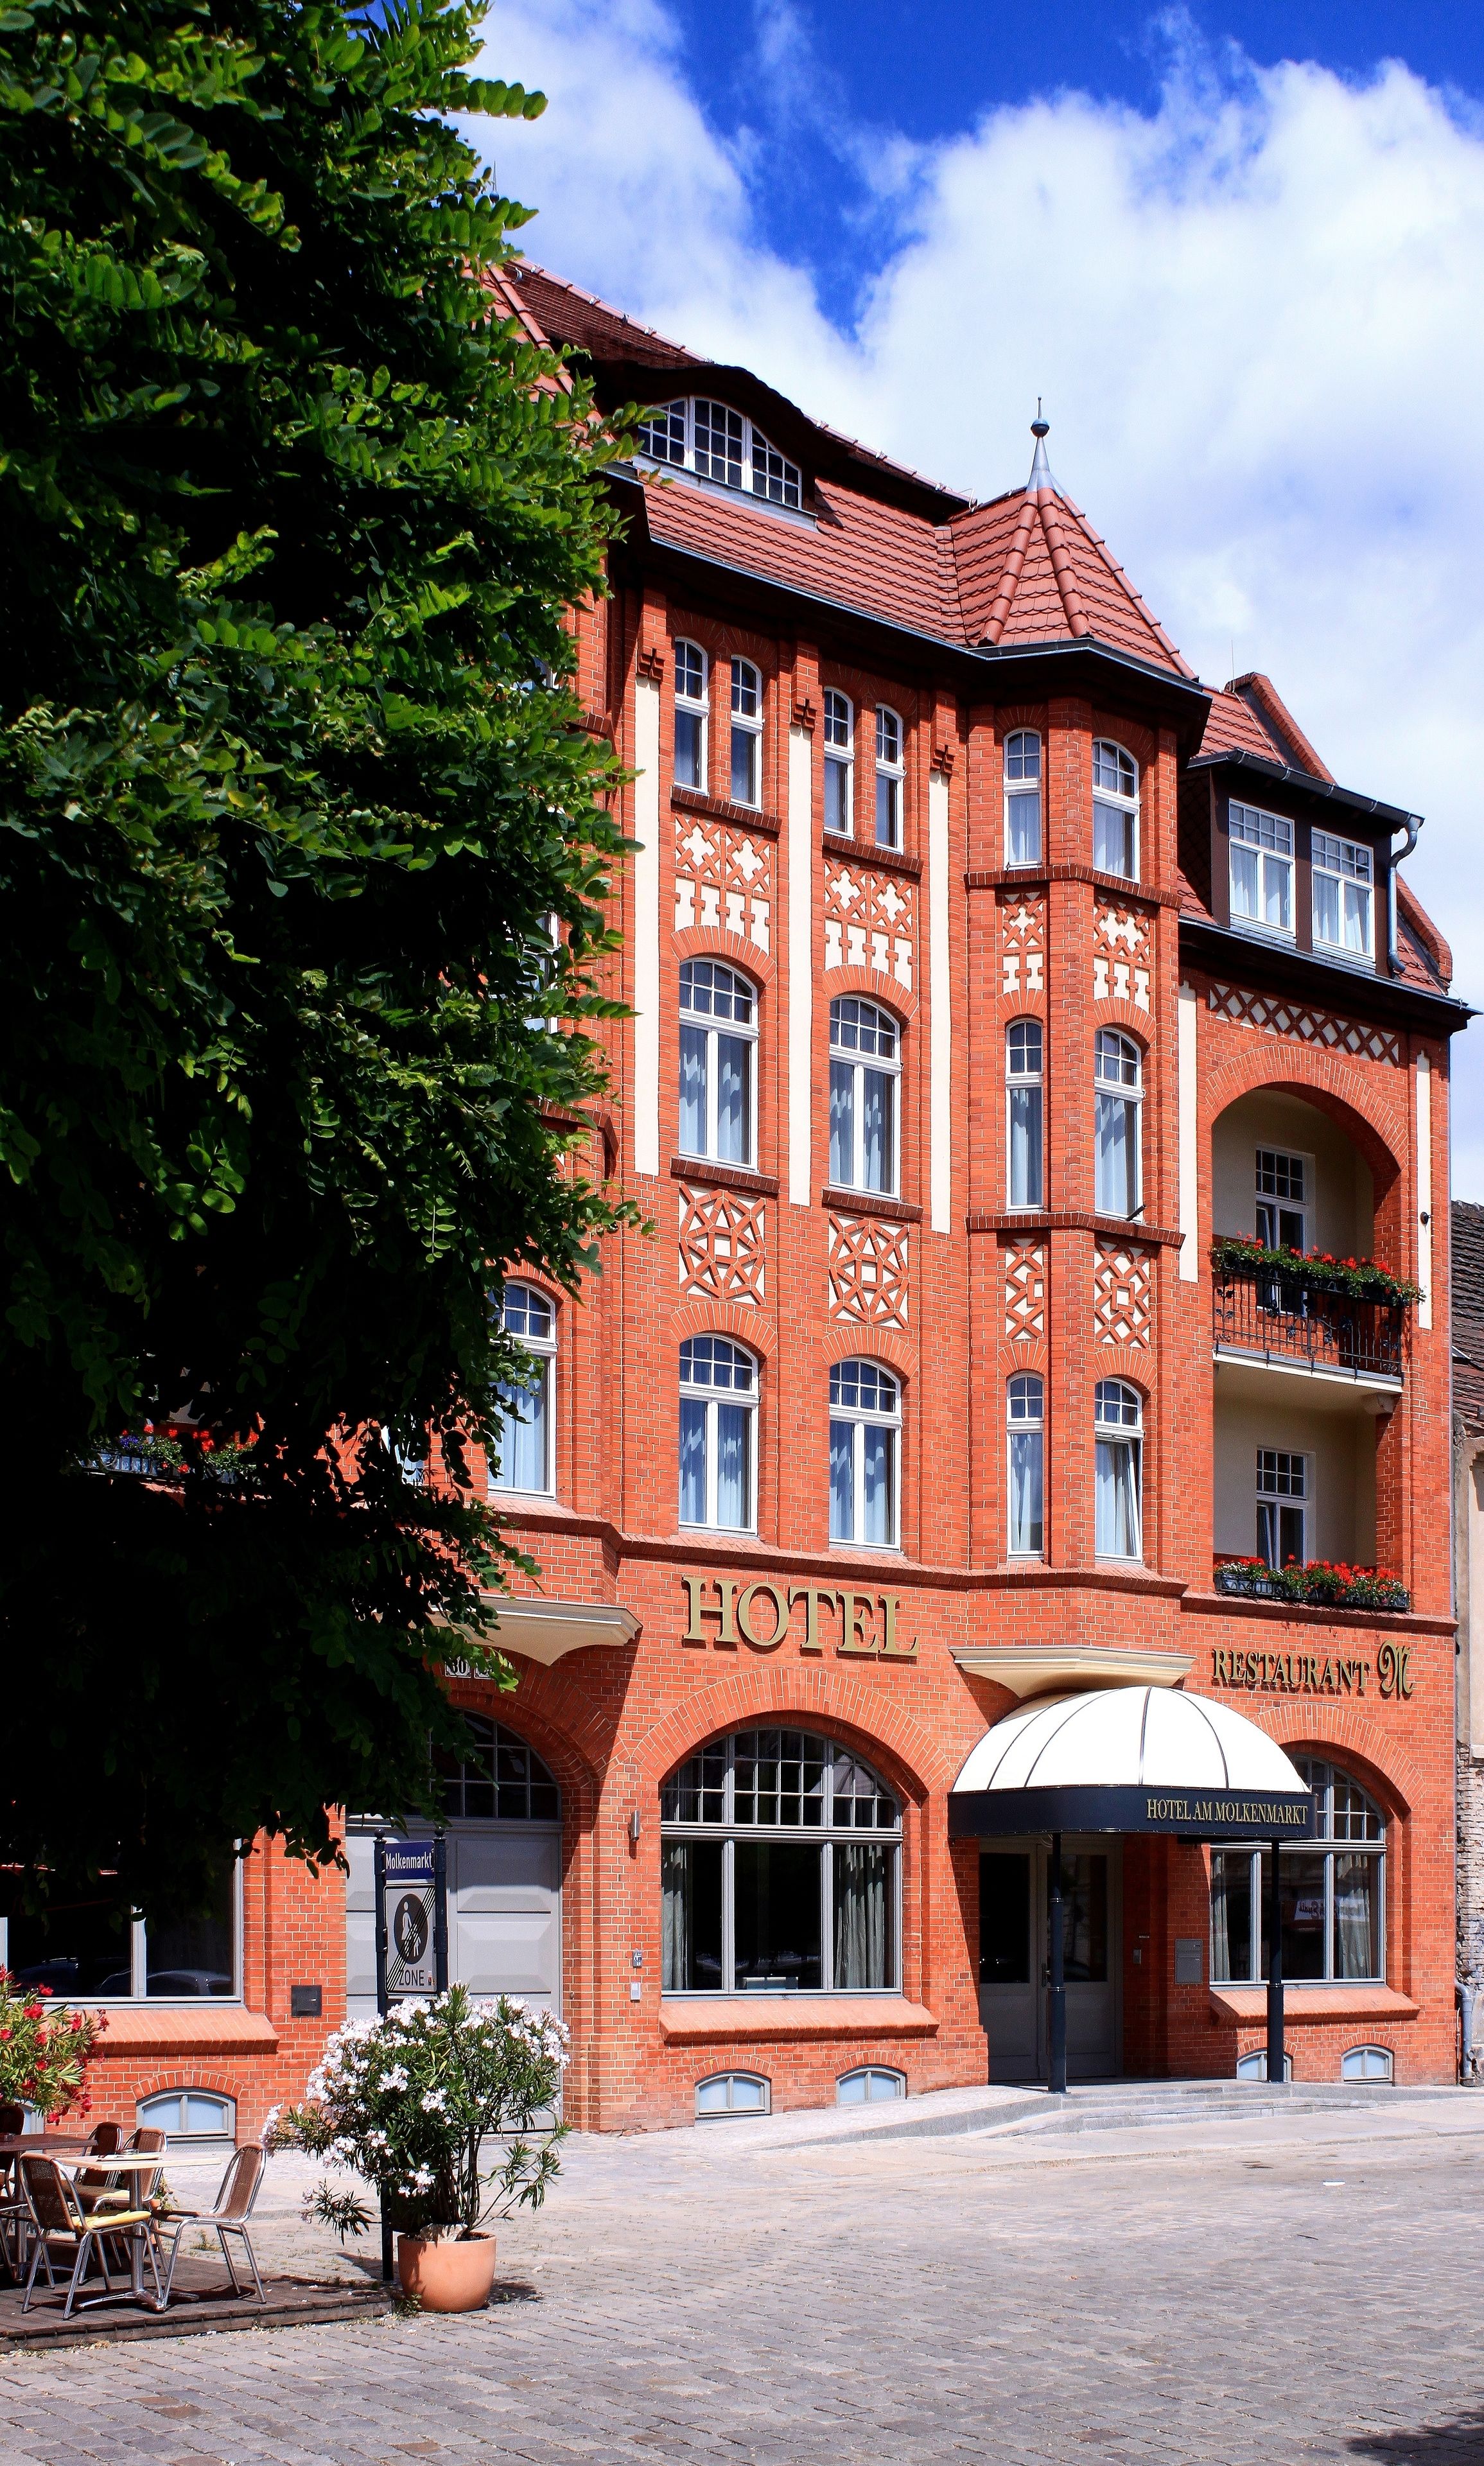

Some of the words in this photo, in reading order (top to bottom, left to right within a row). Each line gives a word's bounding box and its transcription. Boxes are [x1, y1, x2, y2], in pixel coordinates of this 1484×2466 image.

[683, 1575, 919, 1657] HOTEL
[1213, 1648, 1370, 1690] RESTAURANT
[1147, 1799, 1191, 1820] HOTEL
[1192, 1801, 1213, 1821] AM
[1214, 1801, 1308, 1824] MOLKENMARKT
[386, 1851, 432, 1869] Molkenmarkt
[399, 1969, 424, 1986] ZONE
